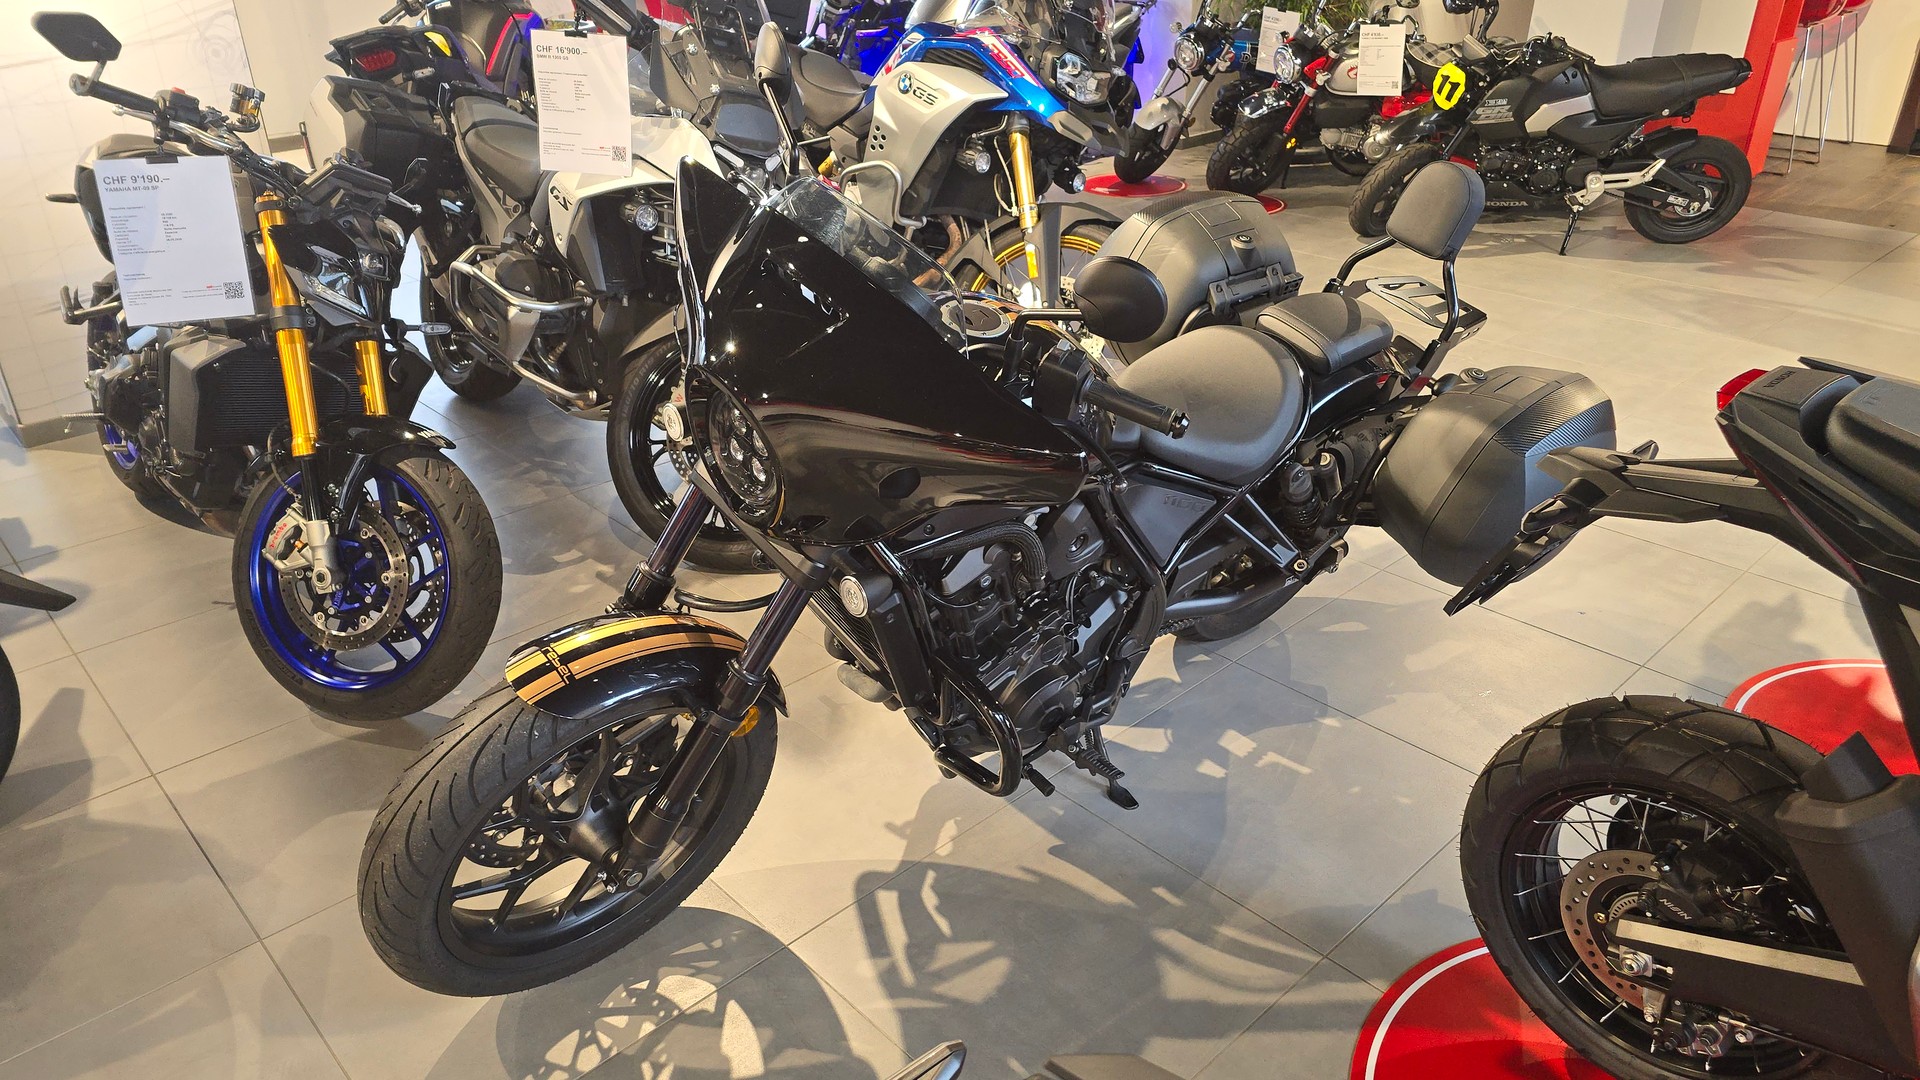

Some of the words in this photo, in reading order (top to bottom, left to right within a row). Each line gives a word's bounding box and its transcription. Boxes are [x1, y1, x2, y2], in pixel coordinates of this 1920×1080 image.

[536, 44, 553, 53] CHF
[912, 86, 938, 106] GS
[1437, 74, 1461, 103] 11
[102, 175, 127, 185] CHF
